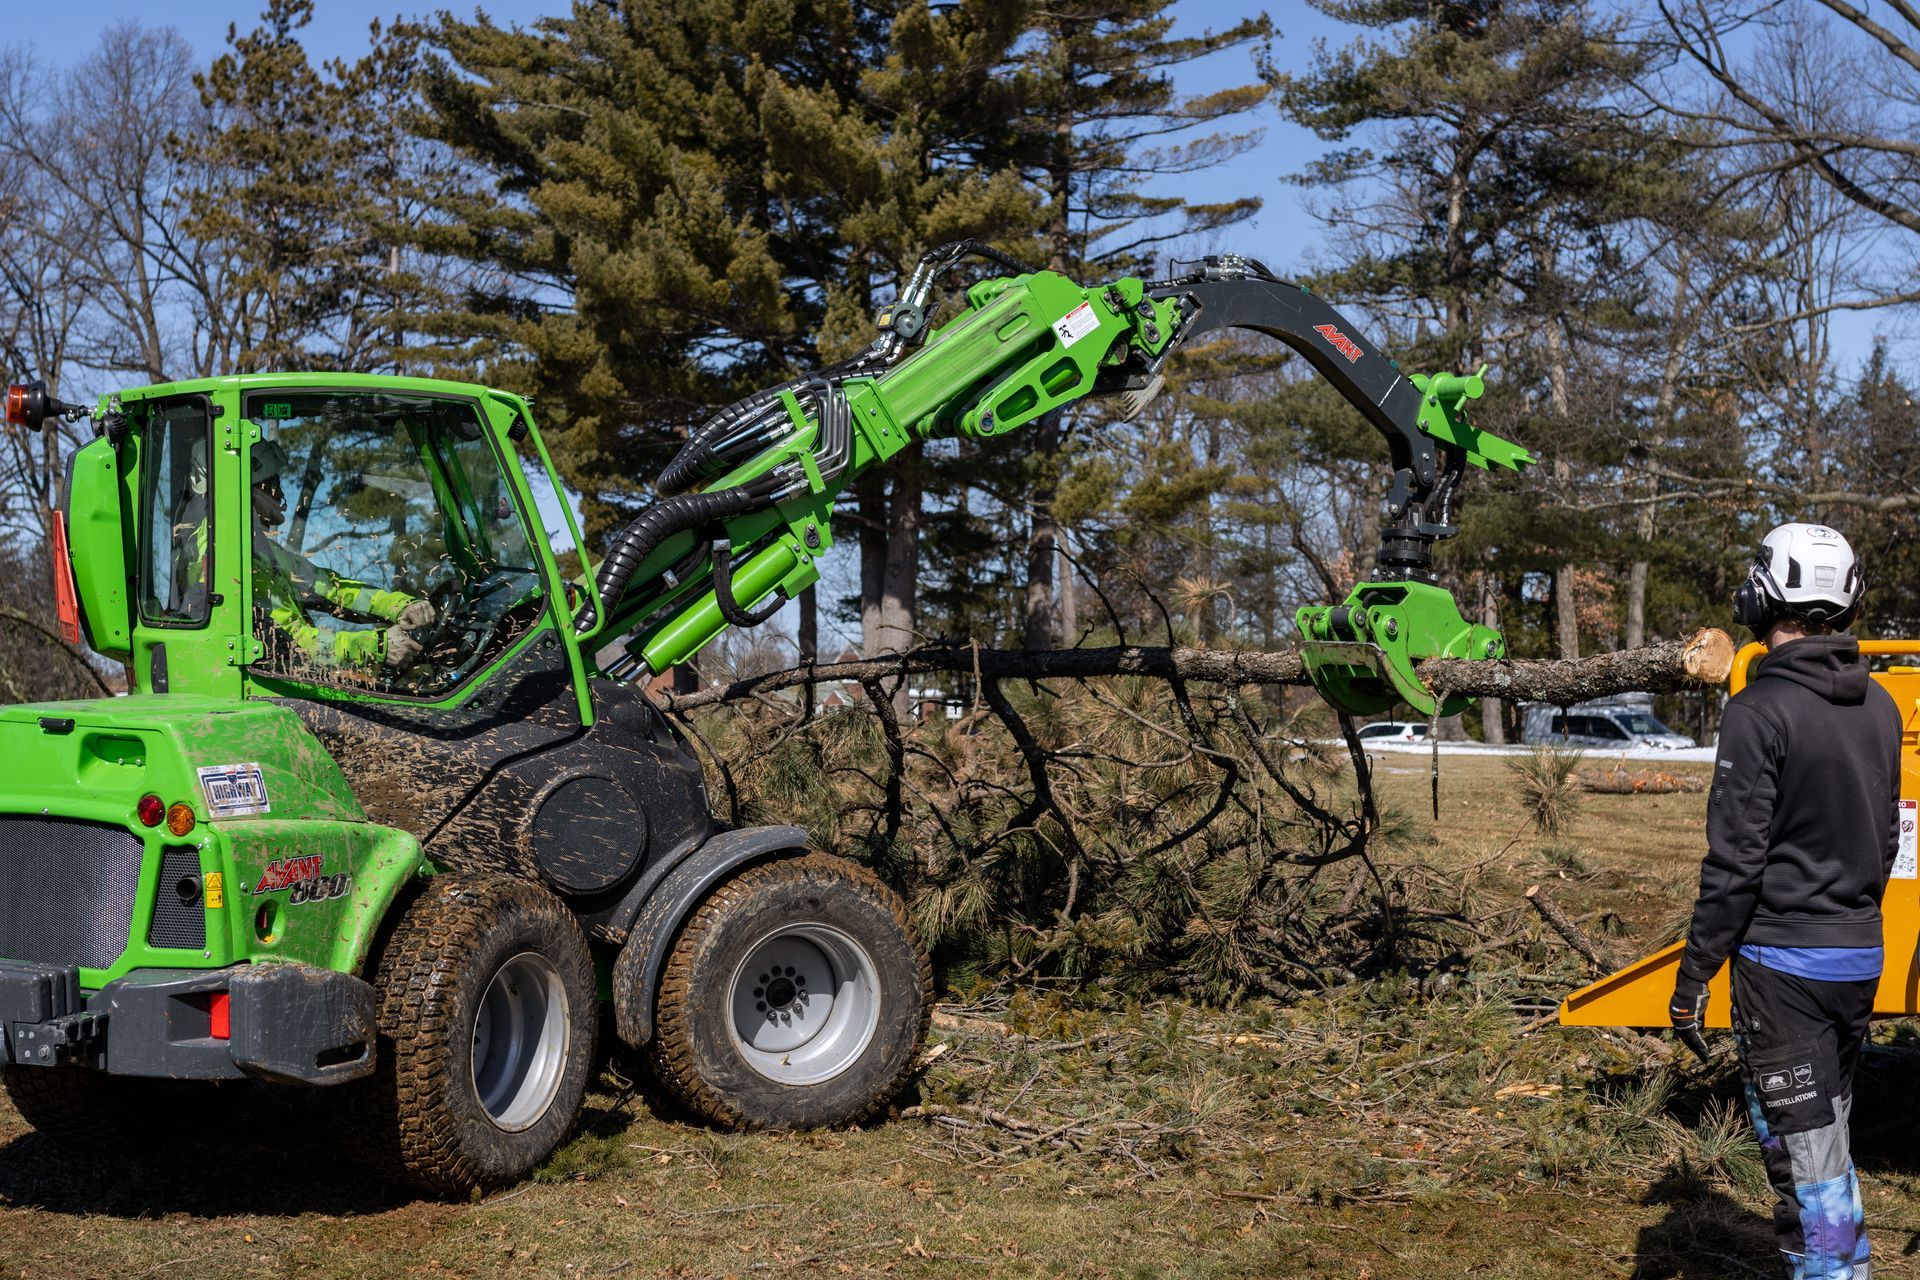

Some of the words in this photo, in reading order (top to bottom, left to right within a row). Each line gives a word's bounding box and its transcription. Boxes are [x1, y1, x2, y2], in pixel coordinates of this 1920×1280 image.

[1313, 324, 1364, 364] AVANT
[254, 855, 323, 893] AVANT
[1766, 1091, 1818, 1108] CONSTELLATIONS
